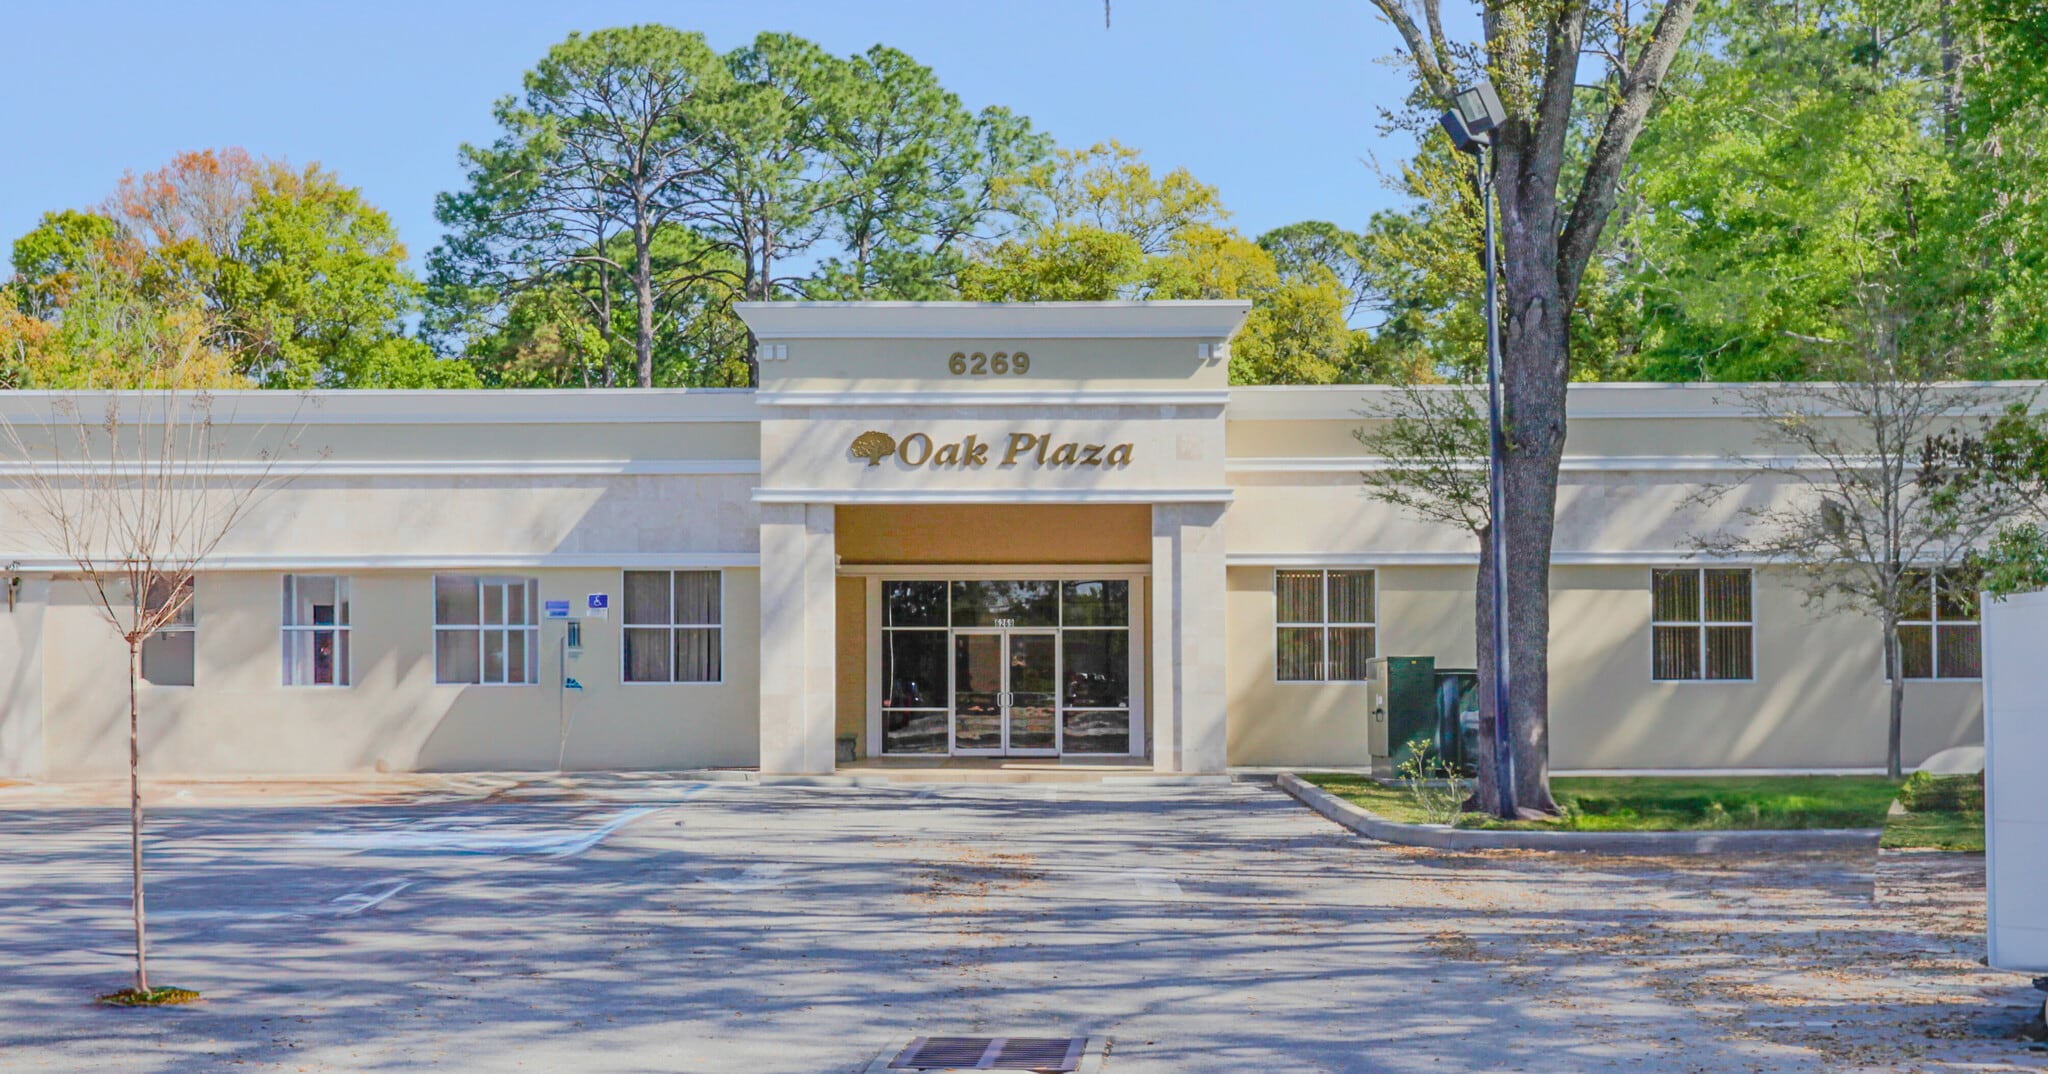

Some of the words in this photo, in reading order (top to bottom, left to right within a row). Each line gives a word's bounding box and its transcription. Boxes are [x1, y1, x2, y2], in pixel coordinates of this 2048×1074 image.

[948, 351, 1030, 375] 6269
[899, 432, 989, 467] Oak
[1001, 432, 1135, 467] Plaza
